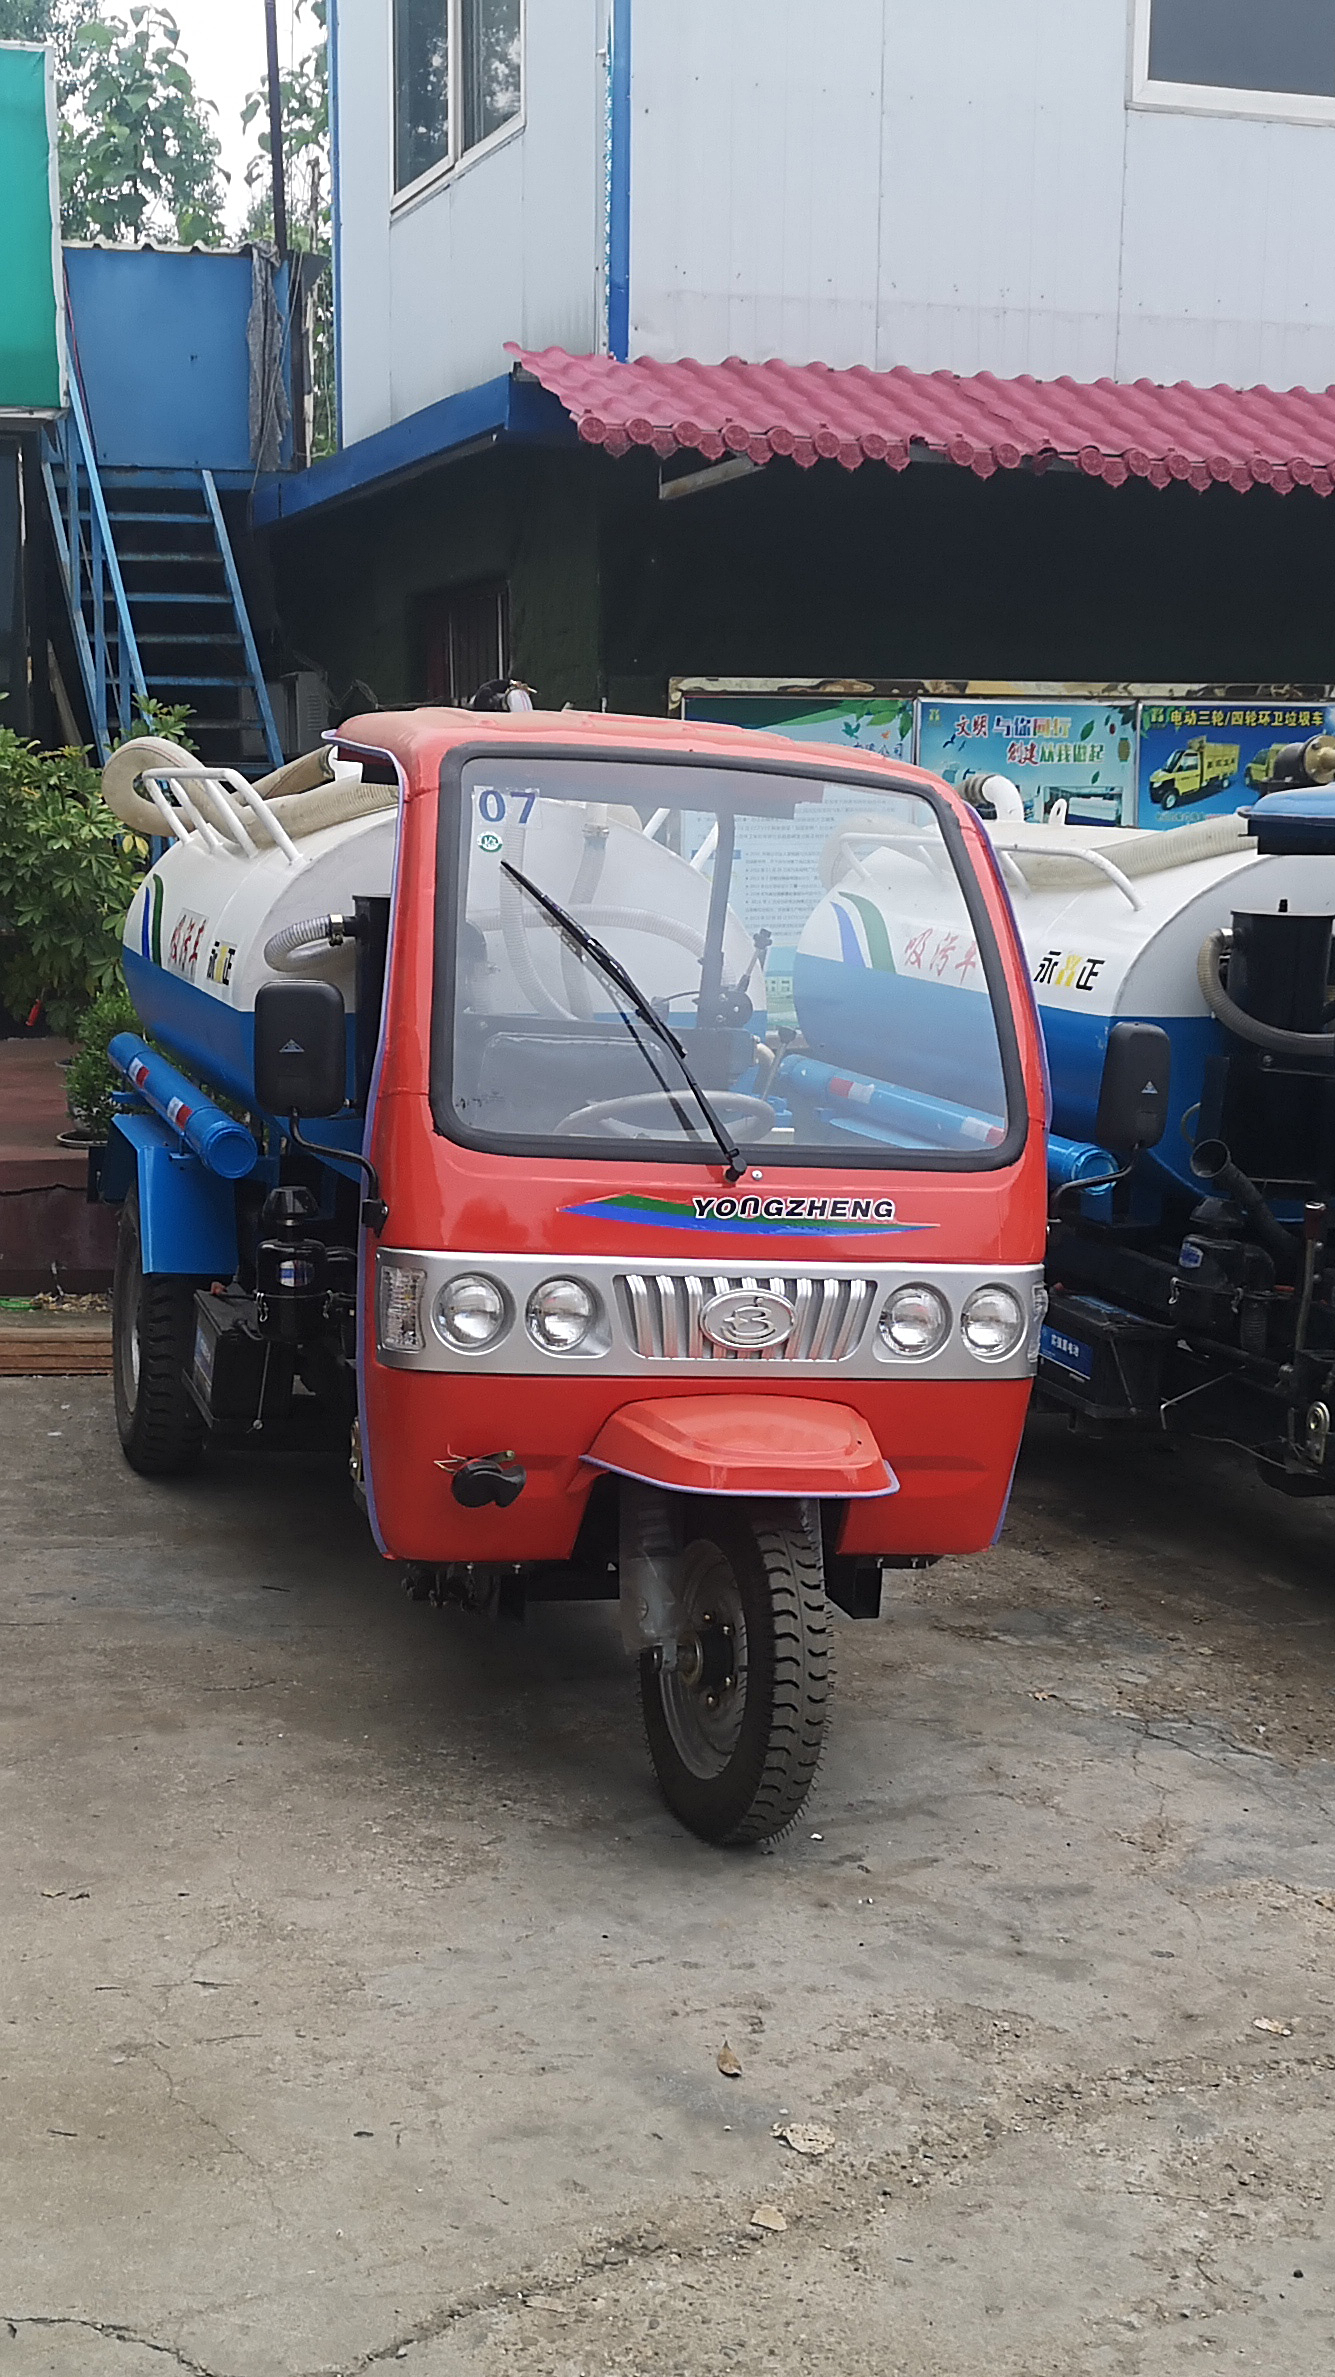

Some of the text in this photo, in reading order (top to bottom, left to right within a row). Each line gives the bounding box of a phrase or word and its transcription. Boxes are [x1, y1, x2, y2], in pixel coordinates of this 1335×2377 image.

[1007, 741, 1104, 765] 创建从我做起
[479, 790, 536, 824] 07
